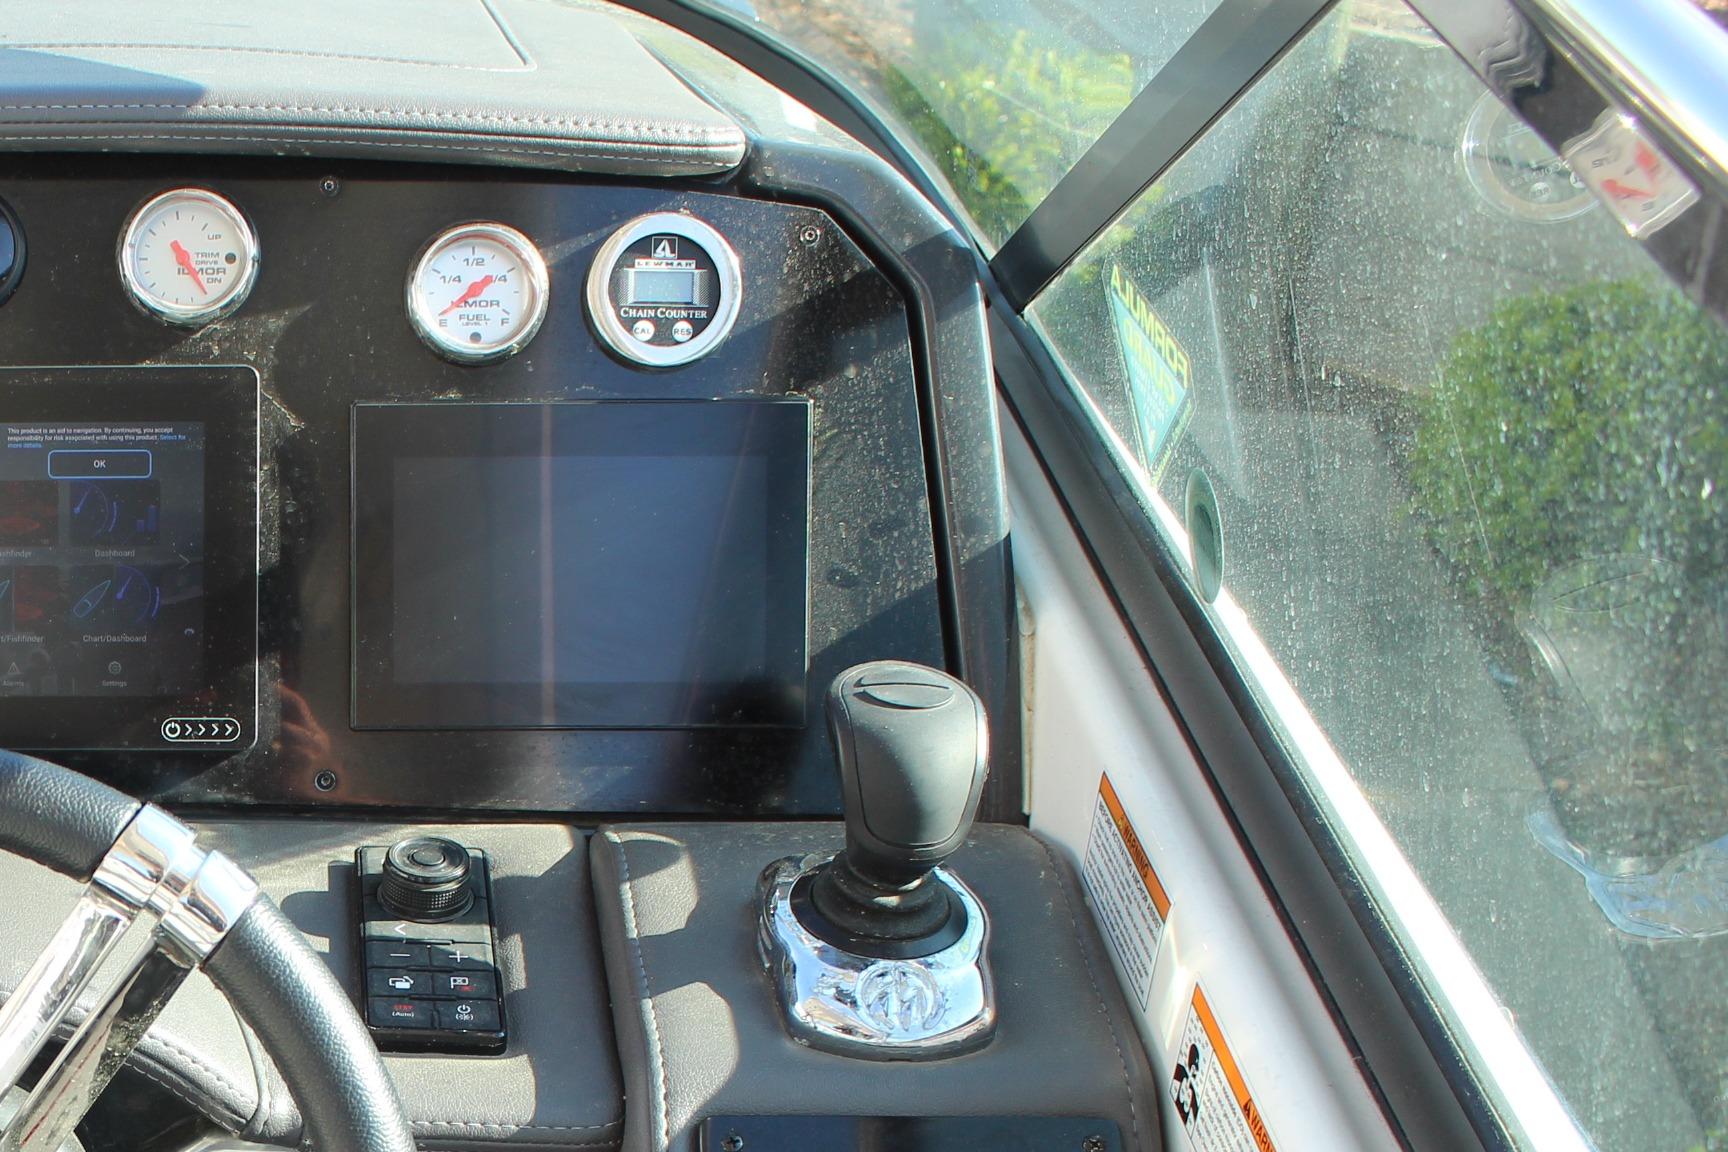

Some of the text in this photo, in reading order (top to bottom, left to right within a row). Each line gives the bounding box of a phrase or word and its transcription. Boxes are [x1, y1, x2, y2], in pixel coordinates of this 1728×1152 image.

[463, 258, 485, 266] 1/2
[440, 275, 461, 283] 1/4
[620, 308, 707, 318] CHAIN COUNTER
[439, 319, 448, 327] E
[501, 318, 509, 326] F
[94, 460, 106, 468] OK
[94, 549, 135, 557] Dashboard
[83, 634, 146, 643] Chart/Dashboard
[1123, 822, 1149, 880] WARNING
